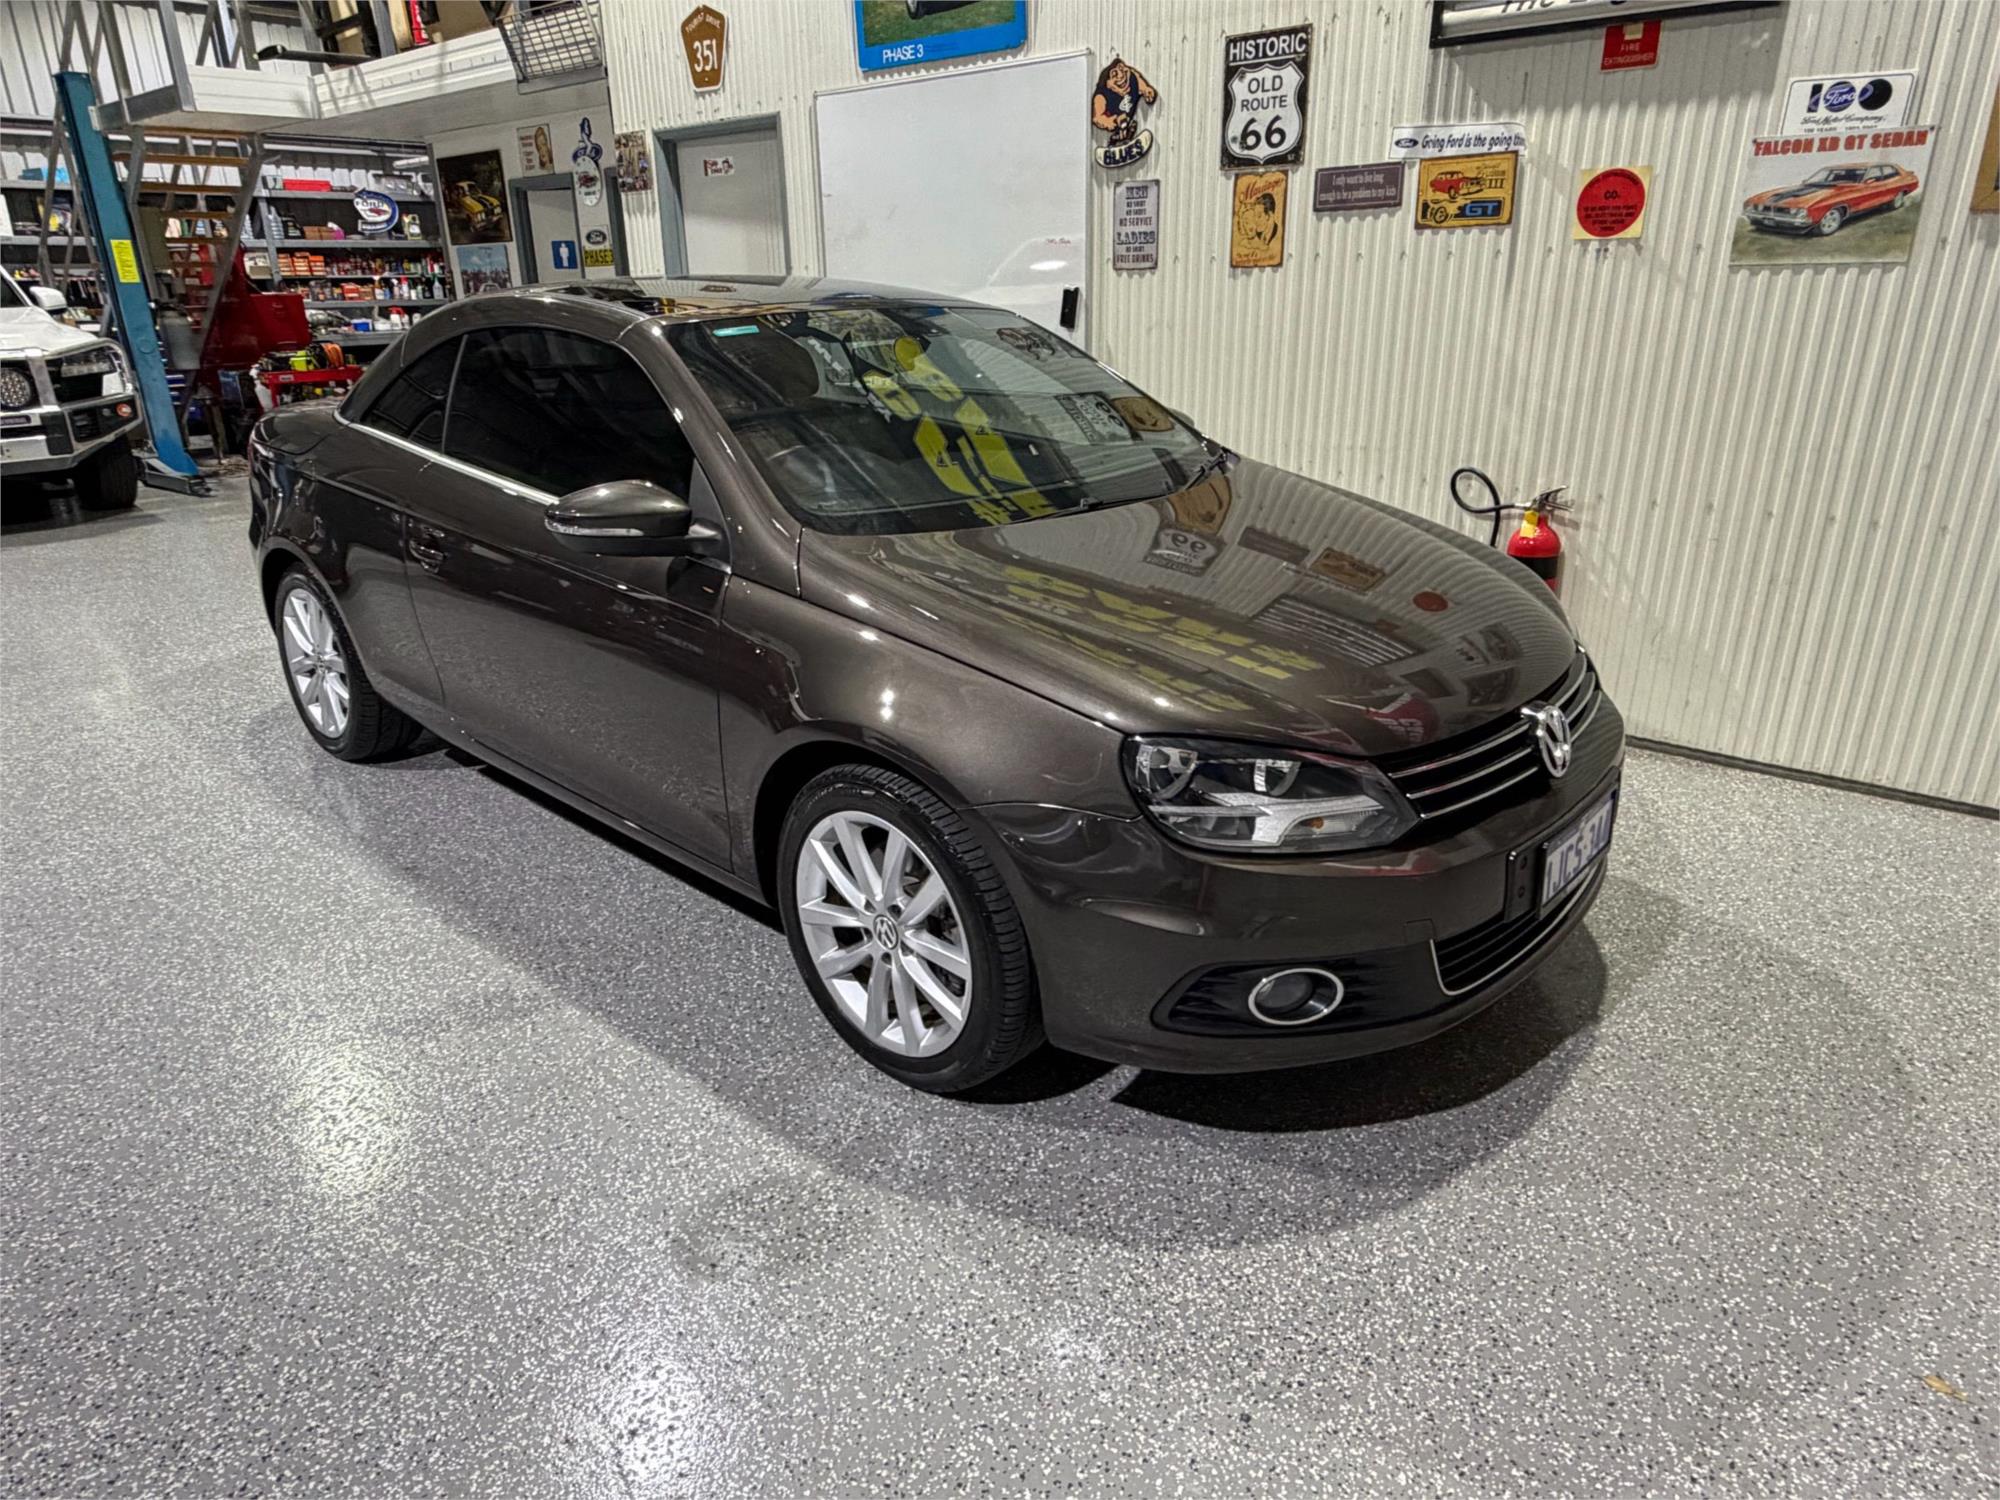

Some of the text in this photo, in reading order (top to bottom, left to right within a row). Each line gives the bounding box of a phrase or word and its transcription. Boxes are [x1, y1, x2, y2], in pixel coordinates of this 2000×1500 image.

[706, 13, 720, 29] DRIVE
[693, 38, 718, 72] 351
[882, 45, 915, 64] PHASE
[917, 44, 924, 58] 3
[1229, 32, 1307, 61] HISTORIC
[1621, 42, 1640, 52] FIRE
[1604, 52, 1655, 66] EXTINGUISHER
[1248, 75, 1283, 94] OLD
[1240, 95, 1288, 112] ROUTE
[1240, 114, 1287, 151] 66
[1421, 134, 1444, 152] Going
[1446, 134, 1465, 148] Ford
[1465, 132, 1472, 148] is
[1473, 133, 1487, 148] the
[1487, 132, 1512, 151] going
[1754, 137, 1814, 156] FALCON
[1844, 134, 1868, 150] GT
[1870, 130, 1929, 148] SEDAN
[1104, 138, 1144, 165] BLUES
[1465, 202, 1499, 216] GT
[1119, 216, 1152, 227] NO SERVICE
[1116, 231, 1155, 245] LADIES
[1116, 253, 1154, 264] FREE DRINKS
